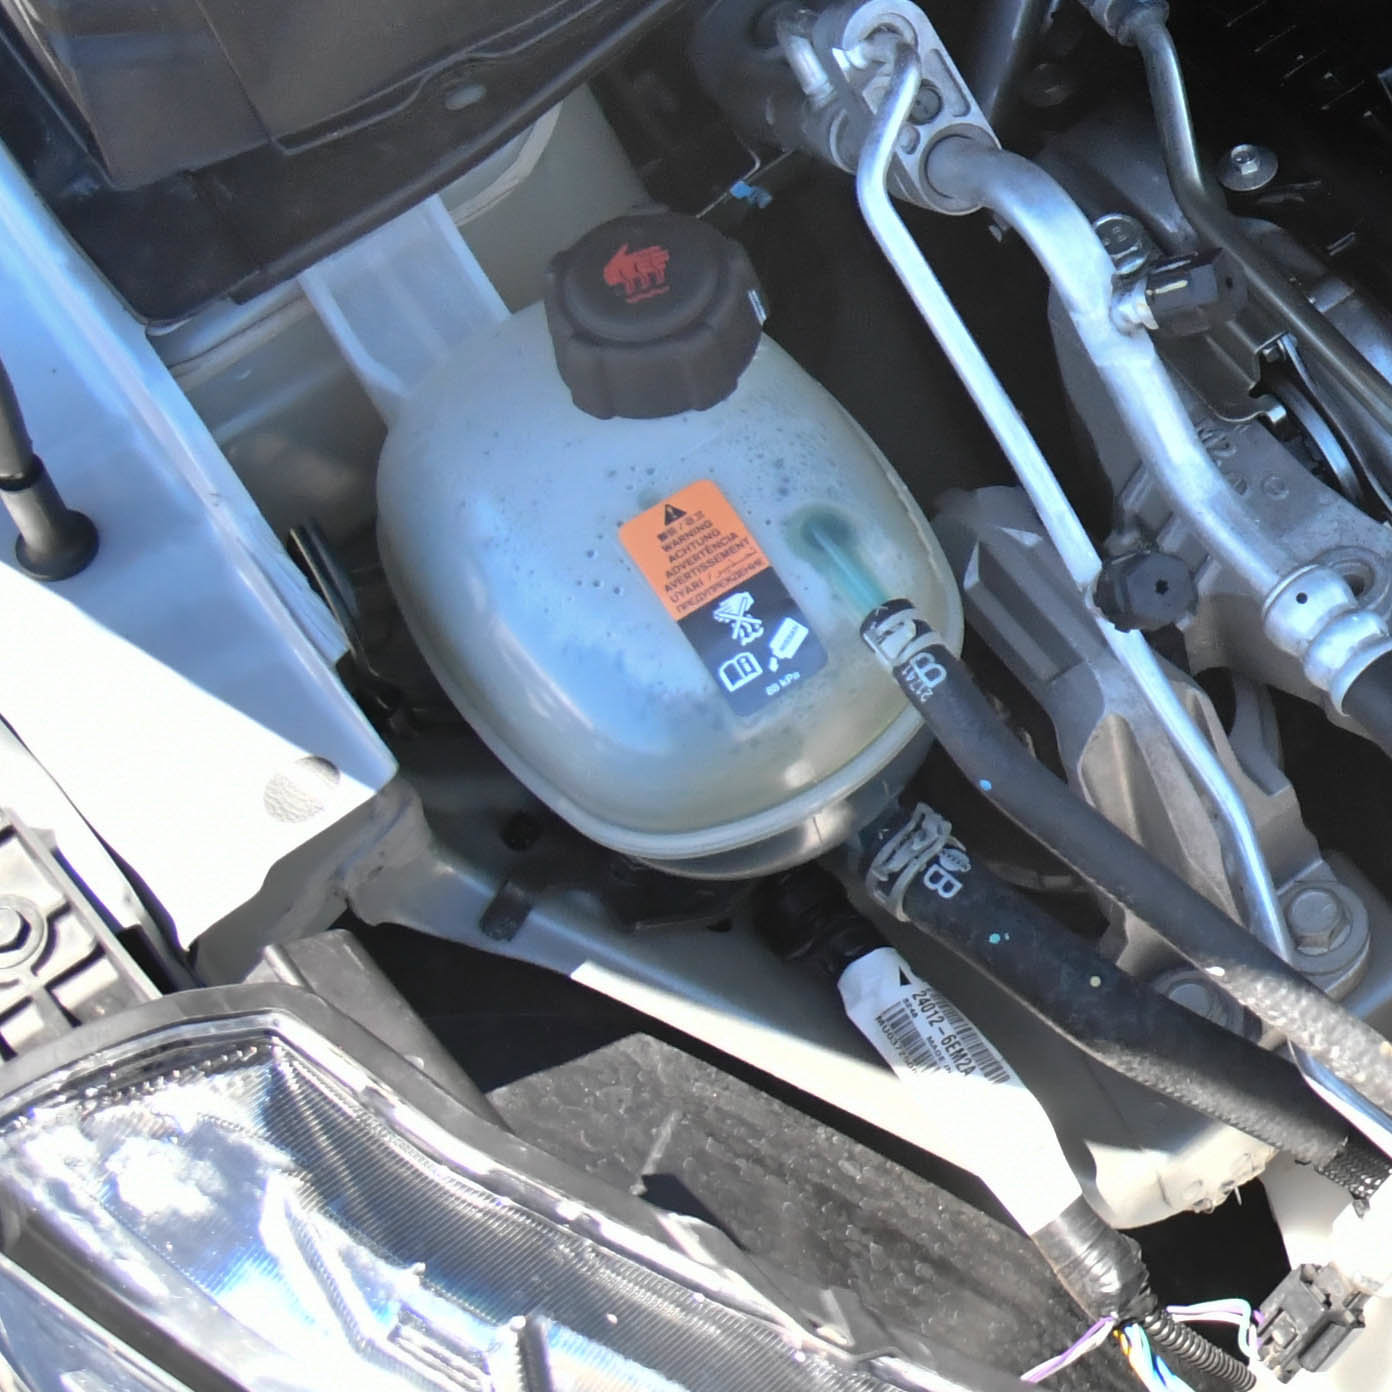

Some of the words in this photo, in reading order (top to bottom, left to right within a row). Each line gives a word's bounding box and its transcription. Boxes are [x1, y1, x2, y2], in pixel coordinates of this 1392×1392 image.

[660, 518, 714, 554] WARNING
[666, 526, 721, 564] ACHTUNG
[663, 535, 751, 593] AVERTISSEMENT
[925, 864, 961, 896] B
[925, 1035, 945, 1062] MADE
